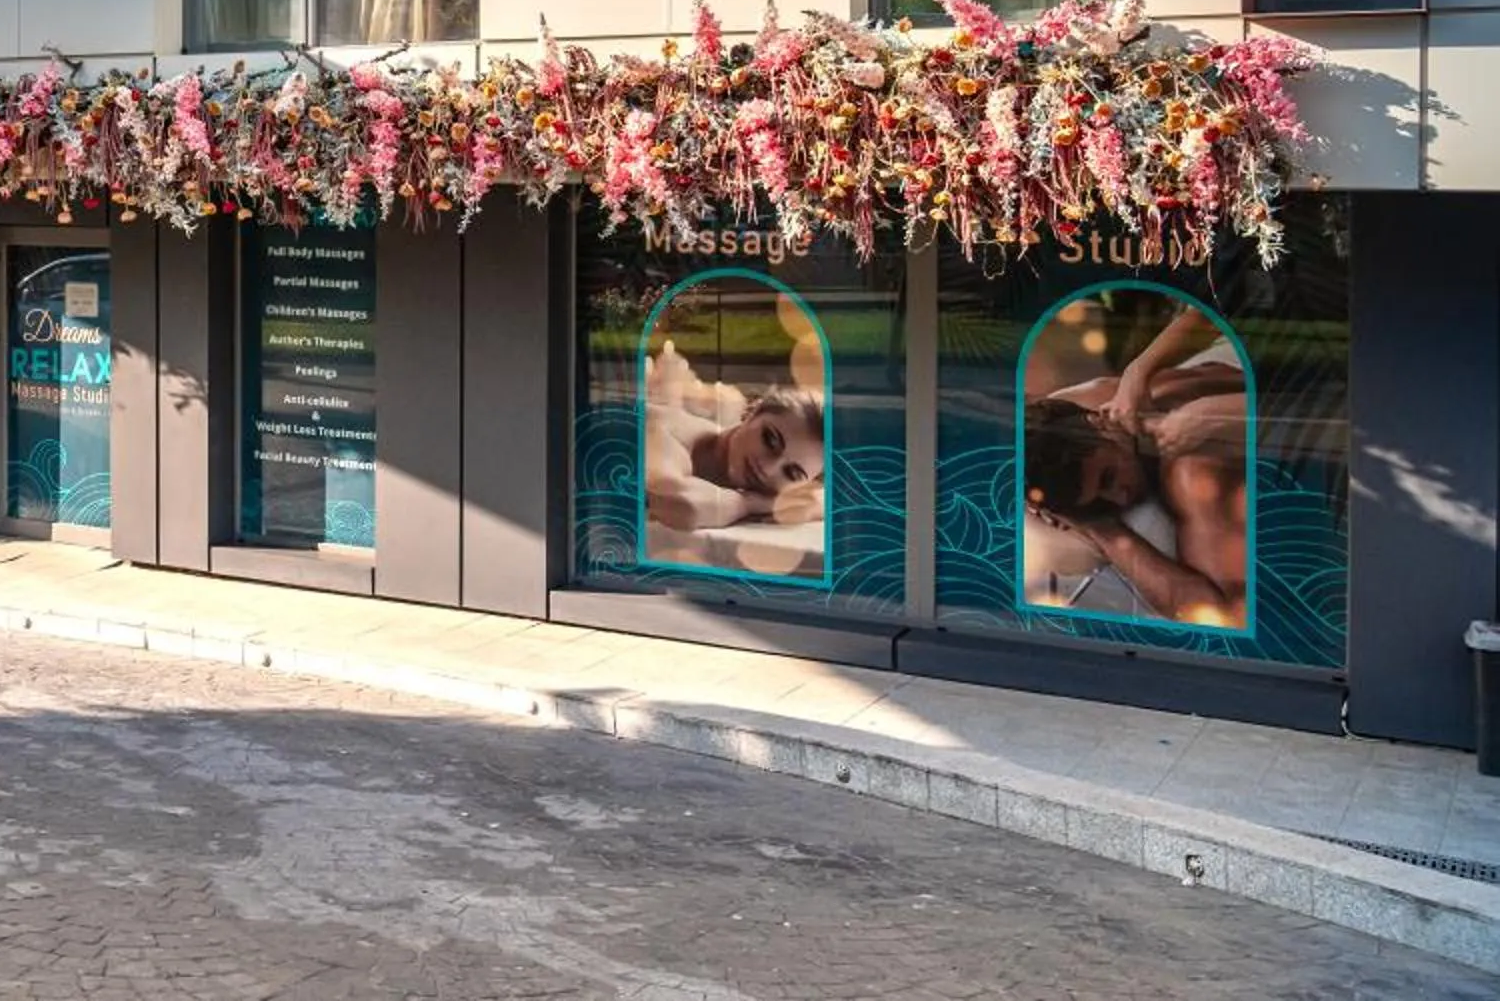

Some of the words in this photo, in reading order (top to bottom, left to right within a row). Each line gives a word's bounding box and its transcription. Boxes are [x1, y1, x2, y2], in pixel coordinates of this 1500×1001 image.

[643, 216, 812, 265] Massage
[267, 246, 287, 257] Full
[288, 247, 312, 260] Body
[315, 247, 366, 262] Massages
[273, 276, 307, 287] Partial
[309, 277, 359, 291] Massages
[265, 304, 315, 317] Children's
[317, 307, 368, 321] Massages
[23, 308, 102, 344] Dreams
[269, 334, 312, 347] Author's
[314, 336, 364, 351] Therapies
[11, 346, 111, 384] RELAX
[295, 365, 338, 380] Peelings
[72, 386, 110, 404] Studi
[311, 410, 321, 421] &
[256, 420, 292, 435] Weight
[293, 425, 317, 436] Loss
[254, 450, 283, 462] Facial
[285, 452, 320, 468] Beauty
[322, 456, 376, 471] Treatment
